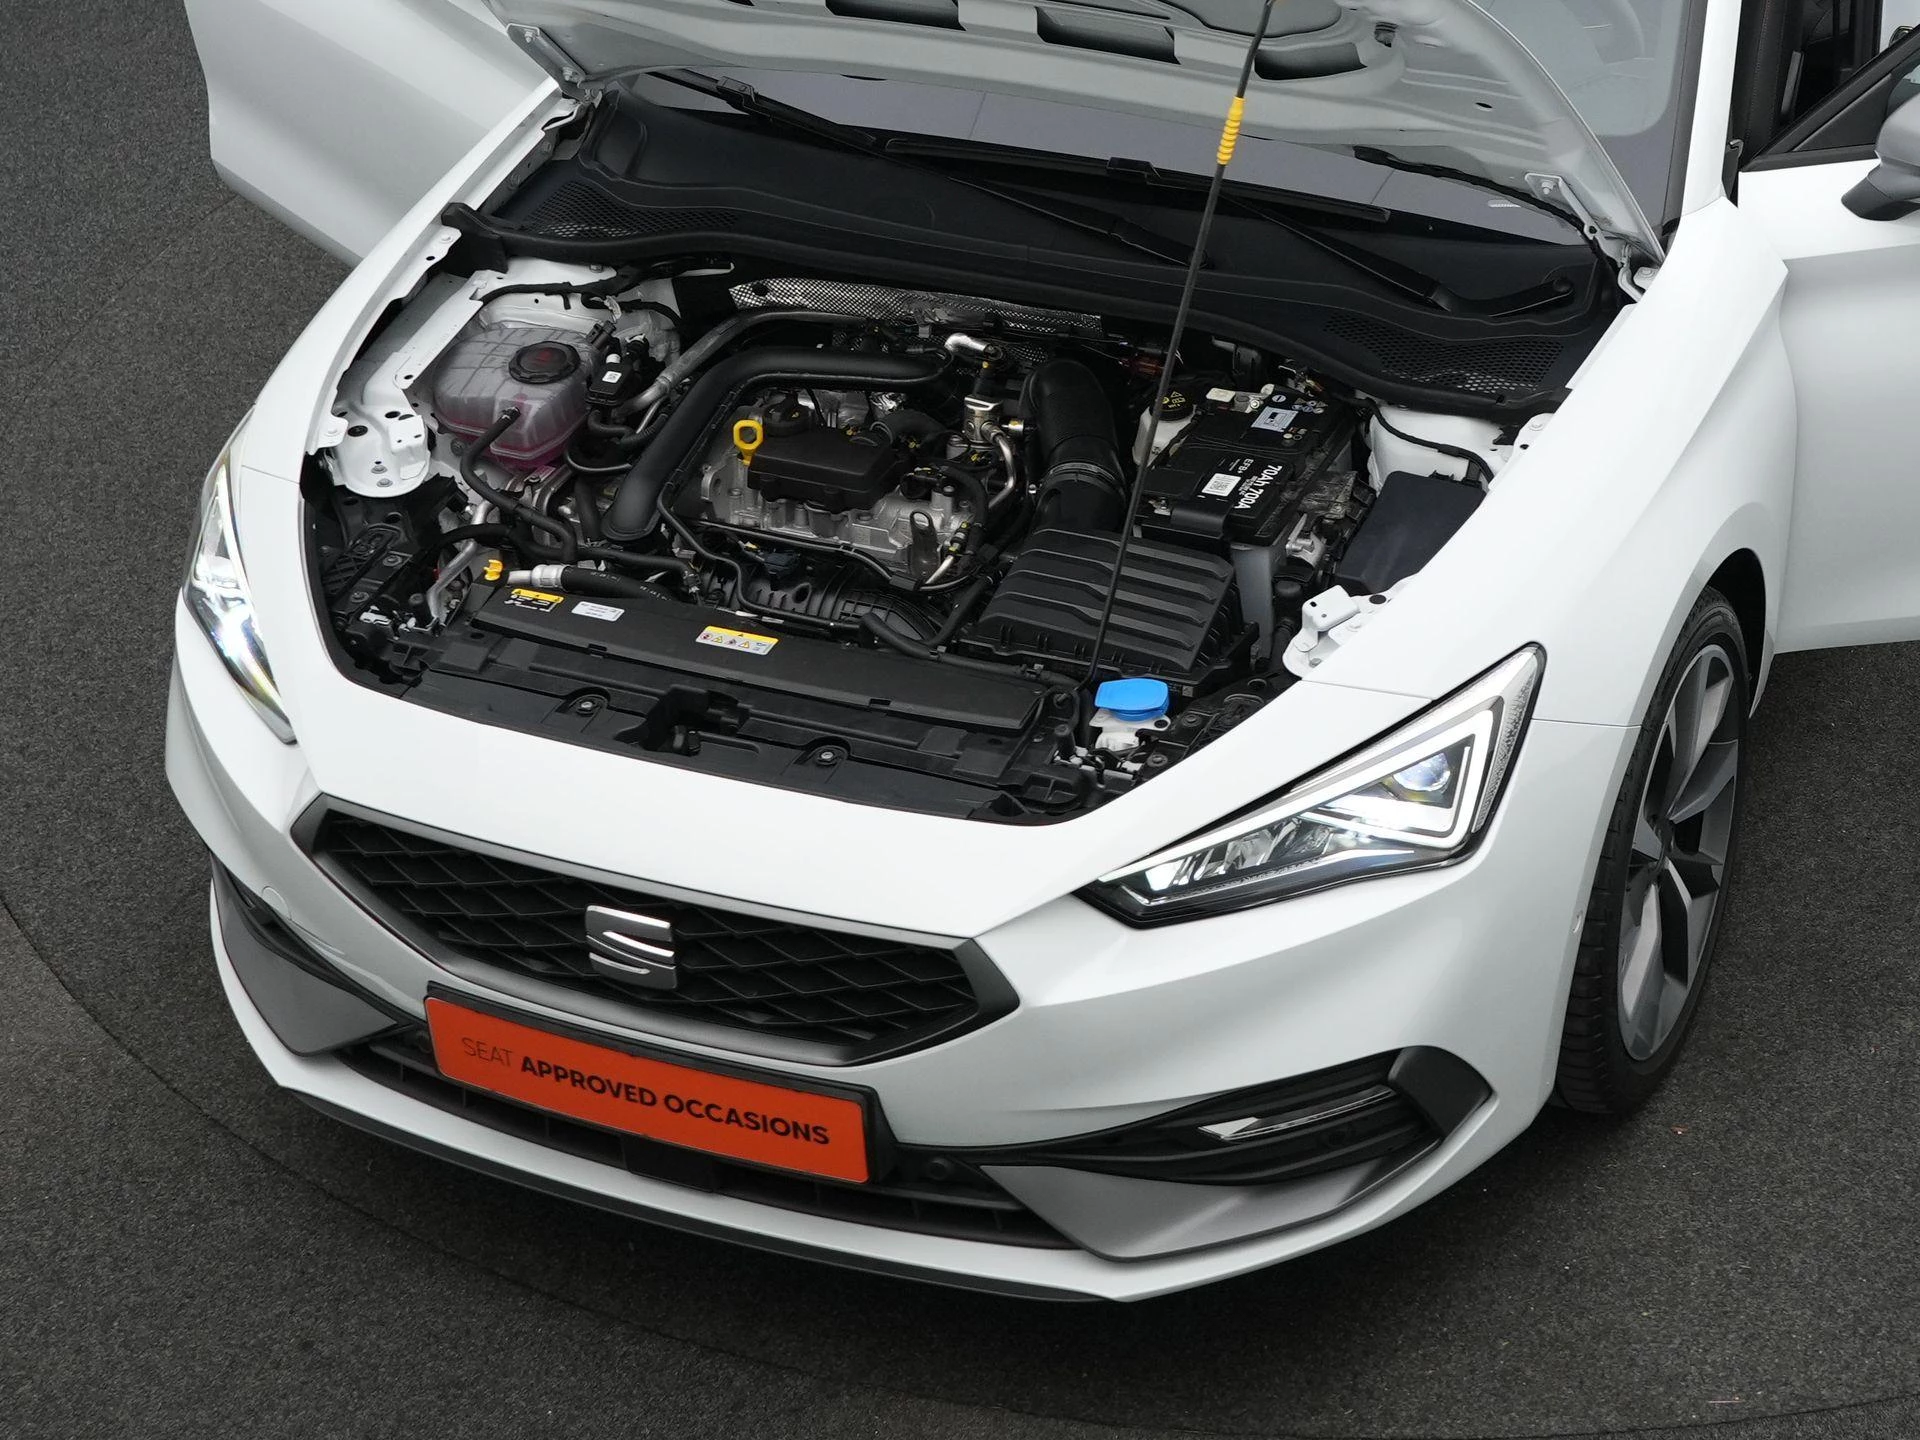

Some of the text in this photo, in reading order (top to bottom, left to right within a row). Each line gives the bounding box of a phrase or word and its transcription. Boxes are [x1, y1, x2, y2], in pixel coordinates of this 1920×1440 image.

[1253, 464, 1283, 487] 70Ah
[1234, 487, 1265, 509] 700A
[461, 1036, 831, 1145] SEAT APPROVED OCCASIONS
